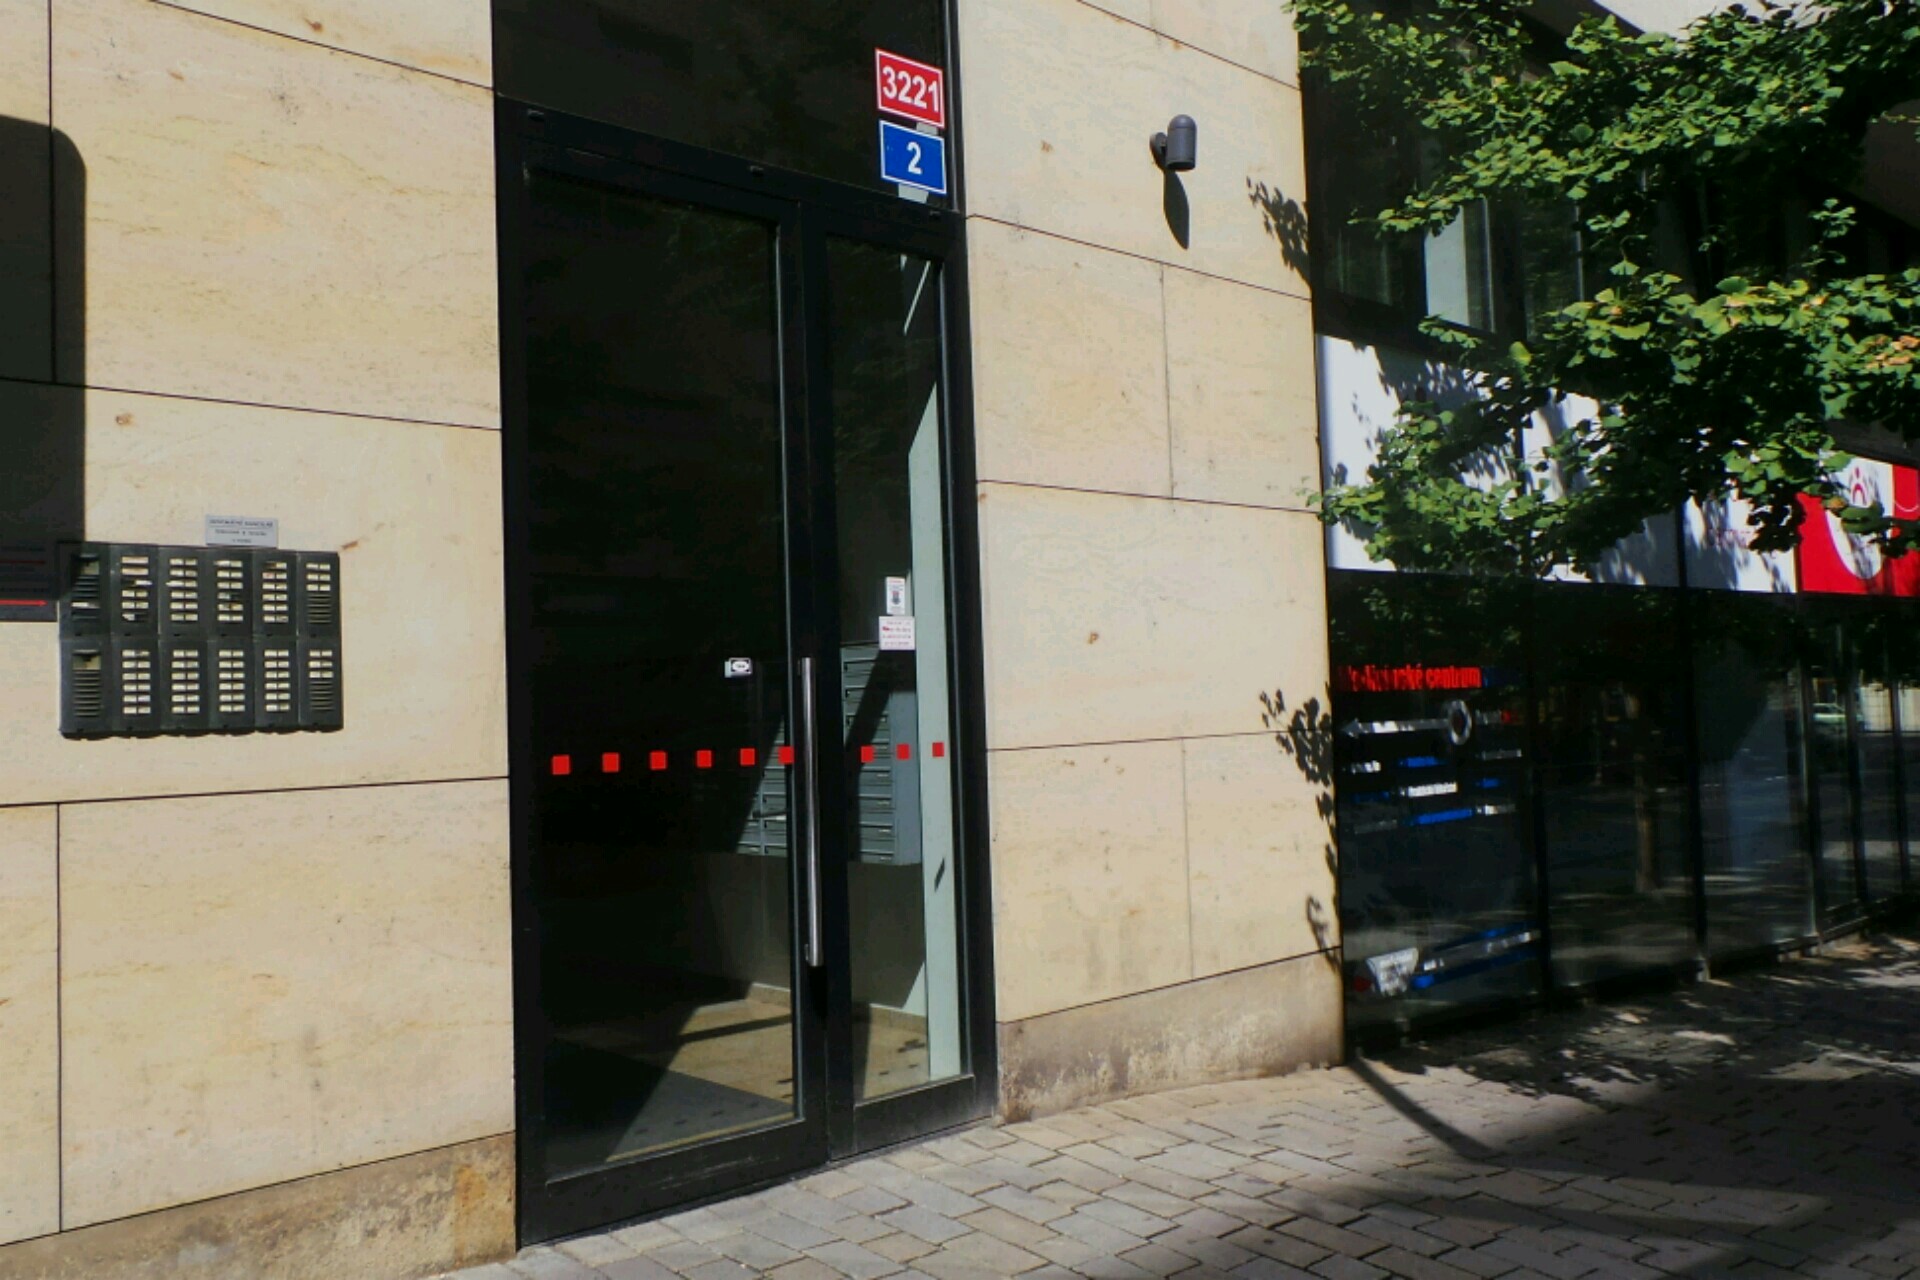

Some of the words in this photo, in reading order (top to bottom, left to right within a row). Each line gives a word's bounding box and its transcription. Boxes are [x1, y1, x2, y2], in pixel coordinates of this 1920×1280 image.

[882, 65, 939, 113] 3221
[906, 141, 923, 175] 2
[1425, 665, 1482, 690] centrum
